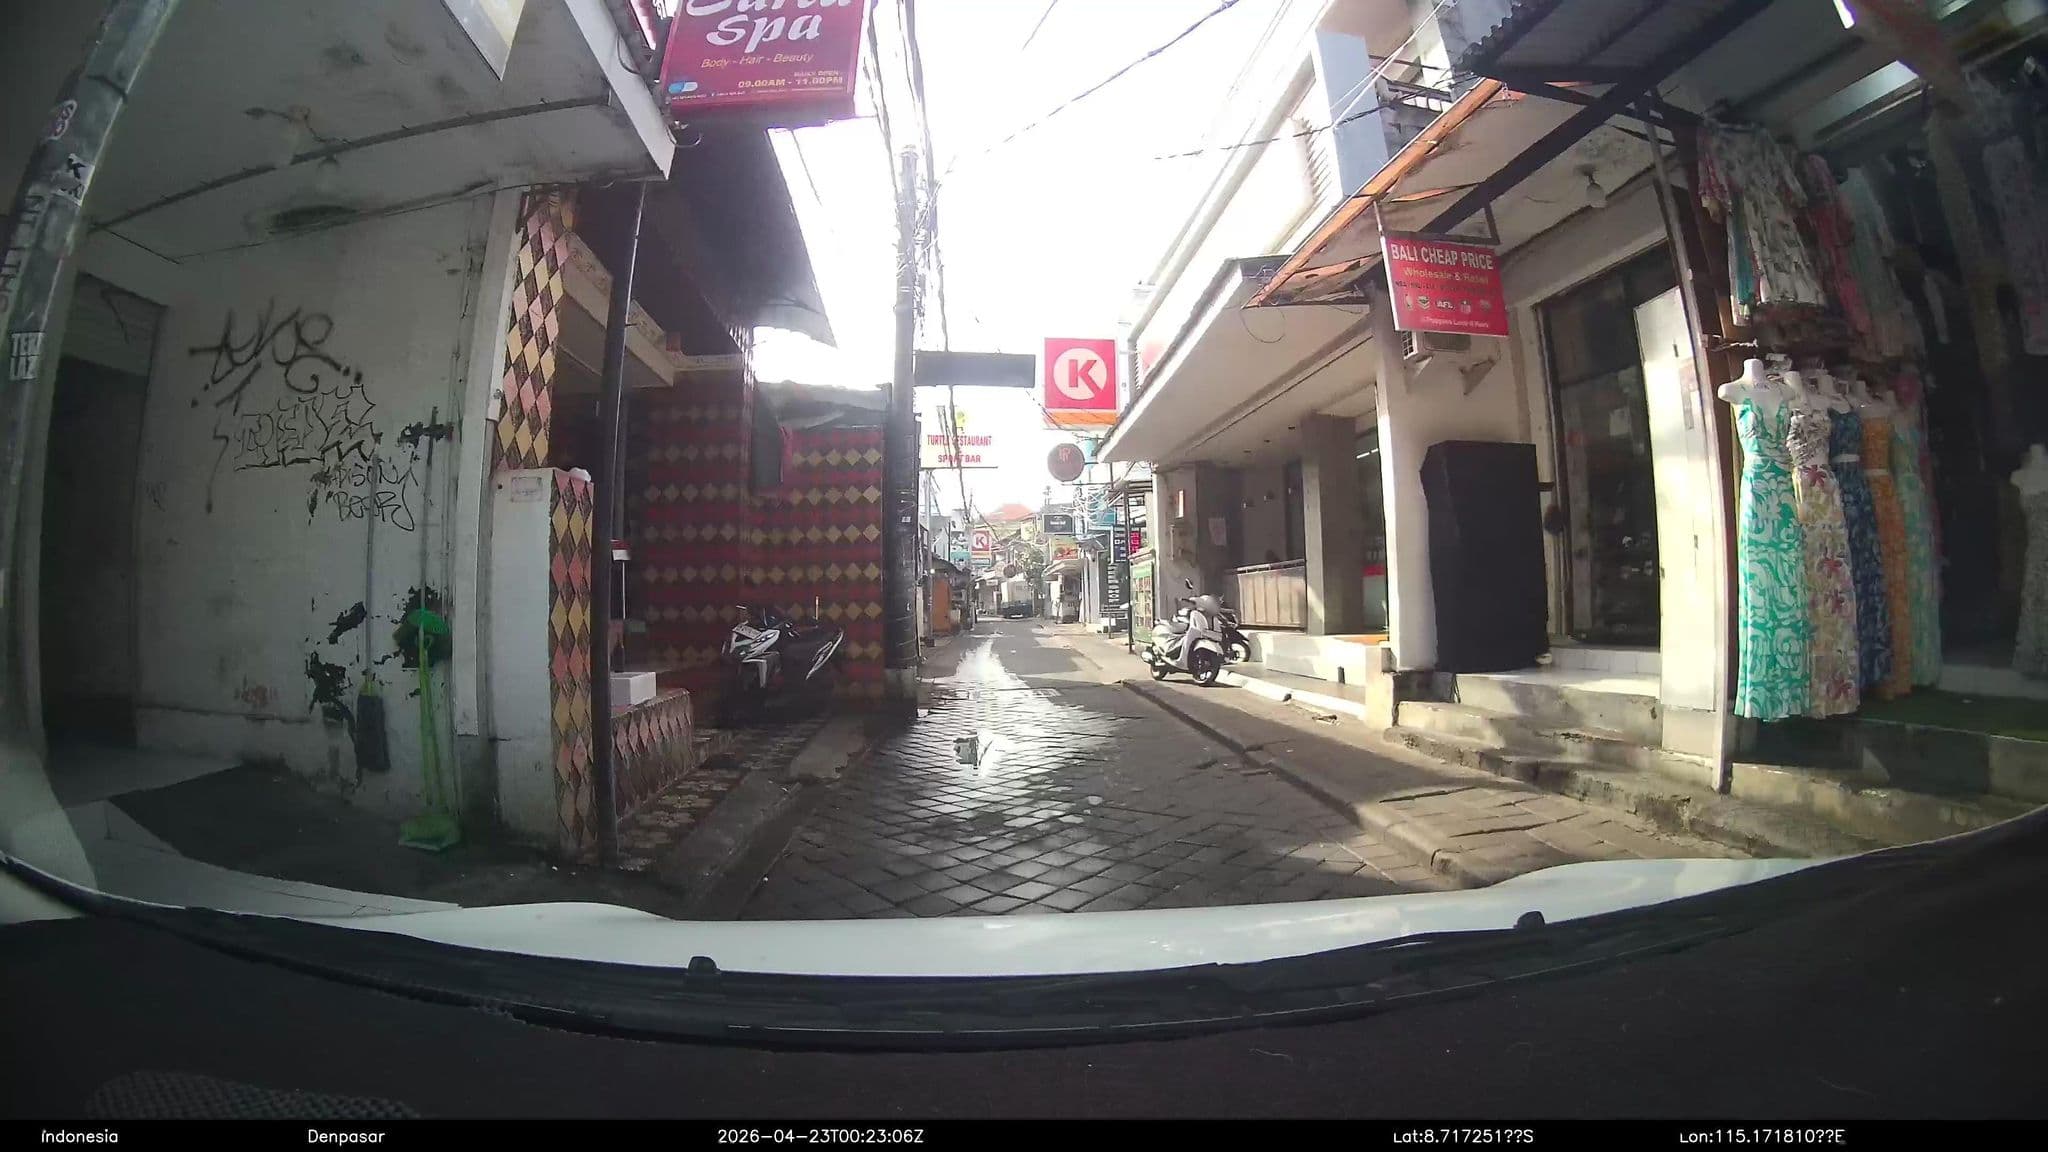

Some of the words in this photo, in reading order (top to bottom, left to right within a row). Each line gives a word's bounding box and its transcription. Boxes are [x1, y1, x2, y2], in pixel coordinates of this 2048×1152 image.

[701, 58, 729, 69] Body
[739, 55, 765, 65] Hair
[773, 53, 814, 64] Beauty
[1391, 244, 1418, 261] BALI
[1421, 247, 1458, 266] CHEAP
[1461, 252, 1494, 270] PRICE
[1404, 267, 1452, 280] Wholesale
[1454, 272, 1461, 280] &
[1069, 359, 1103, 398] K
[927, 434, 950, 446] TURTL
[951, 435, 992, 446] STAURANT
[964, 454, 981, 463] BAR
